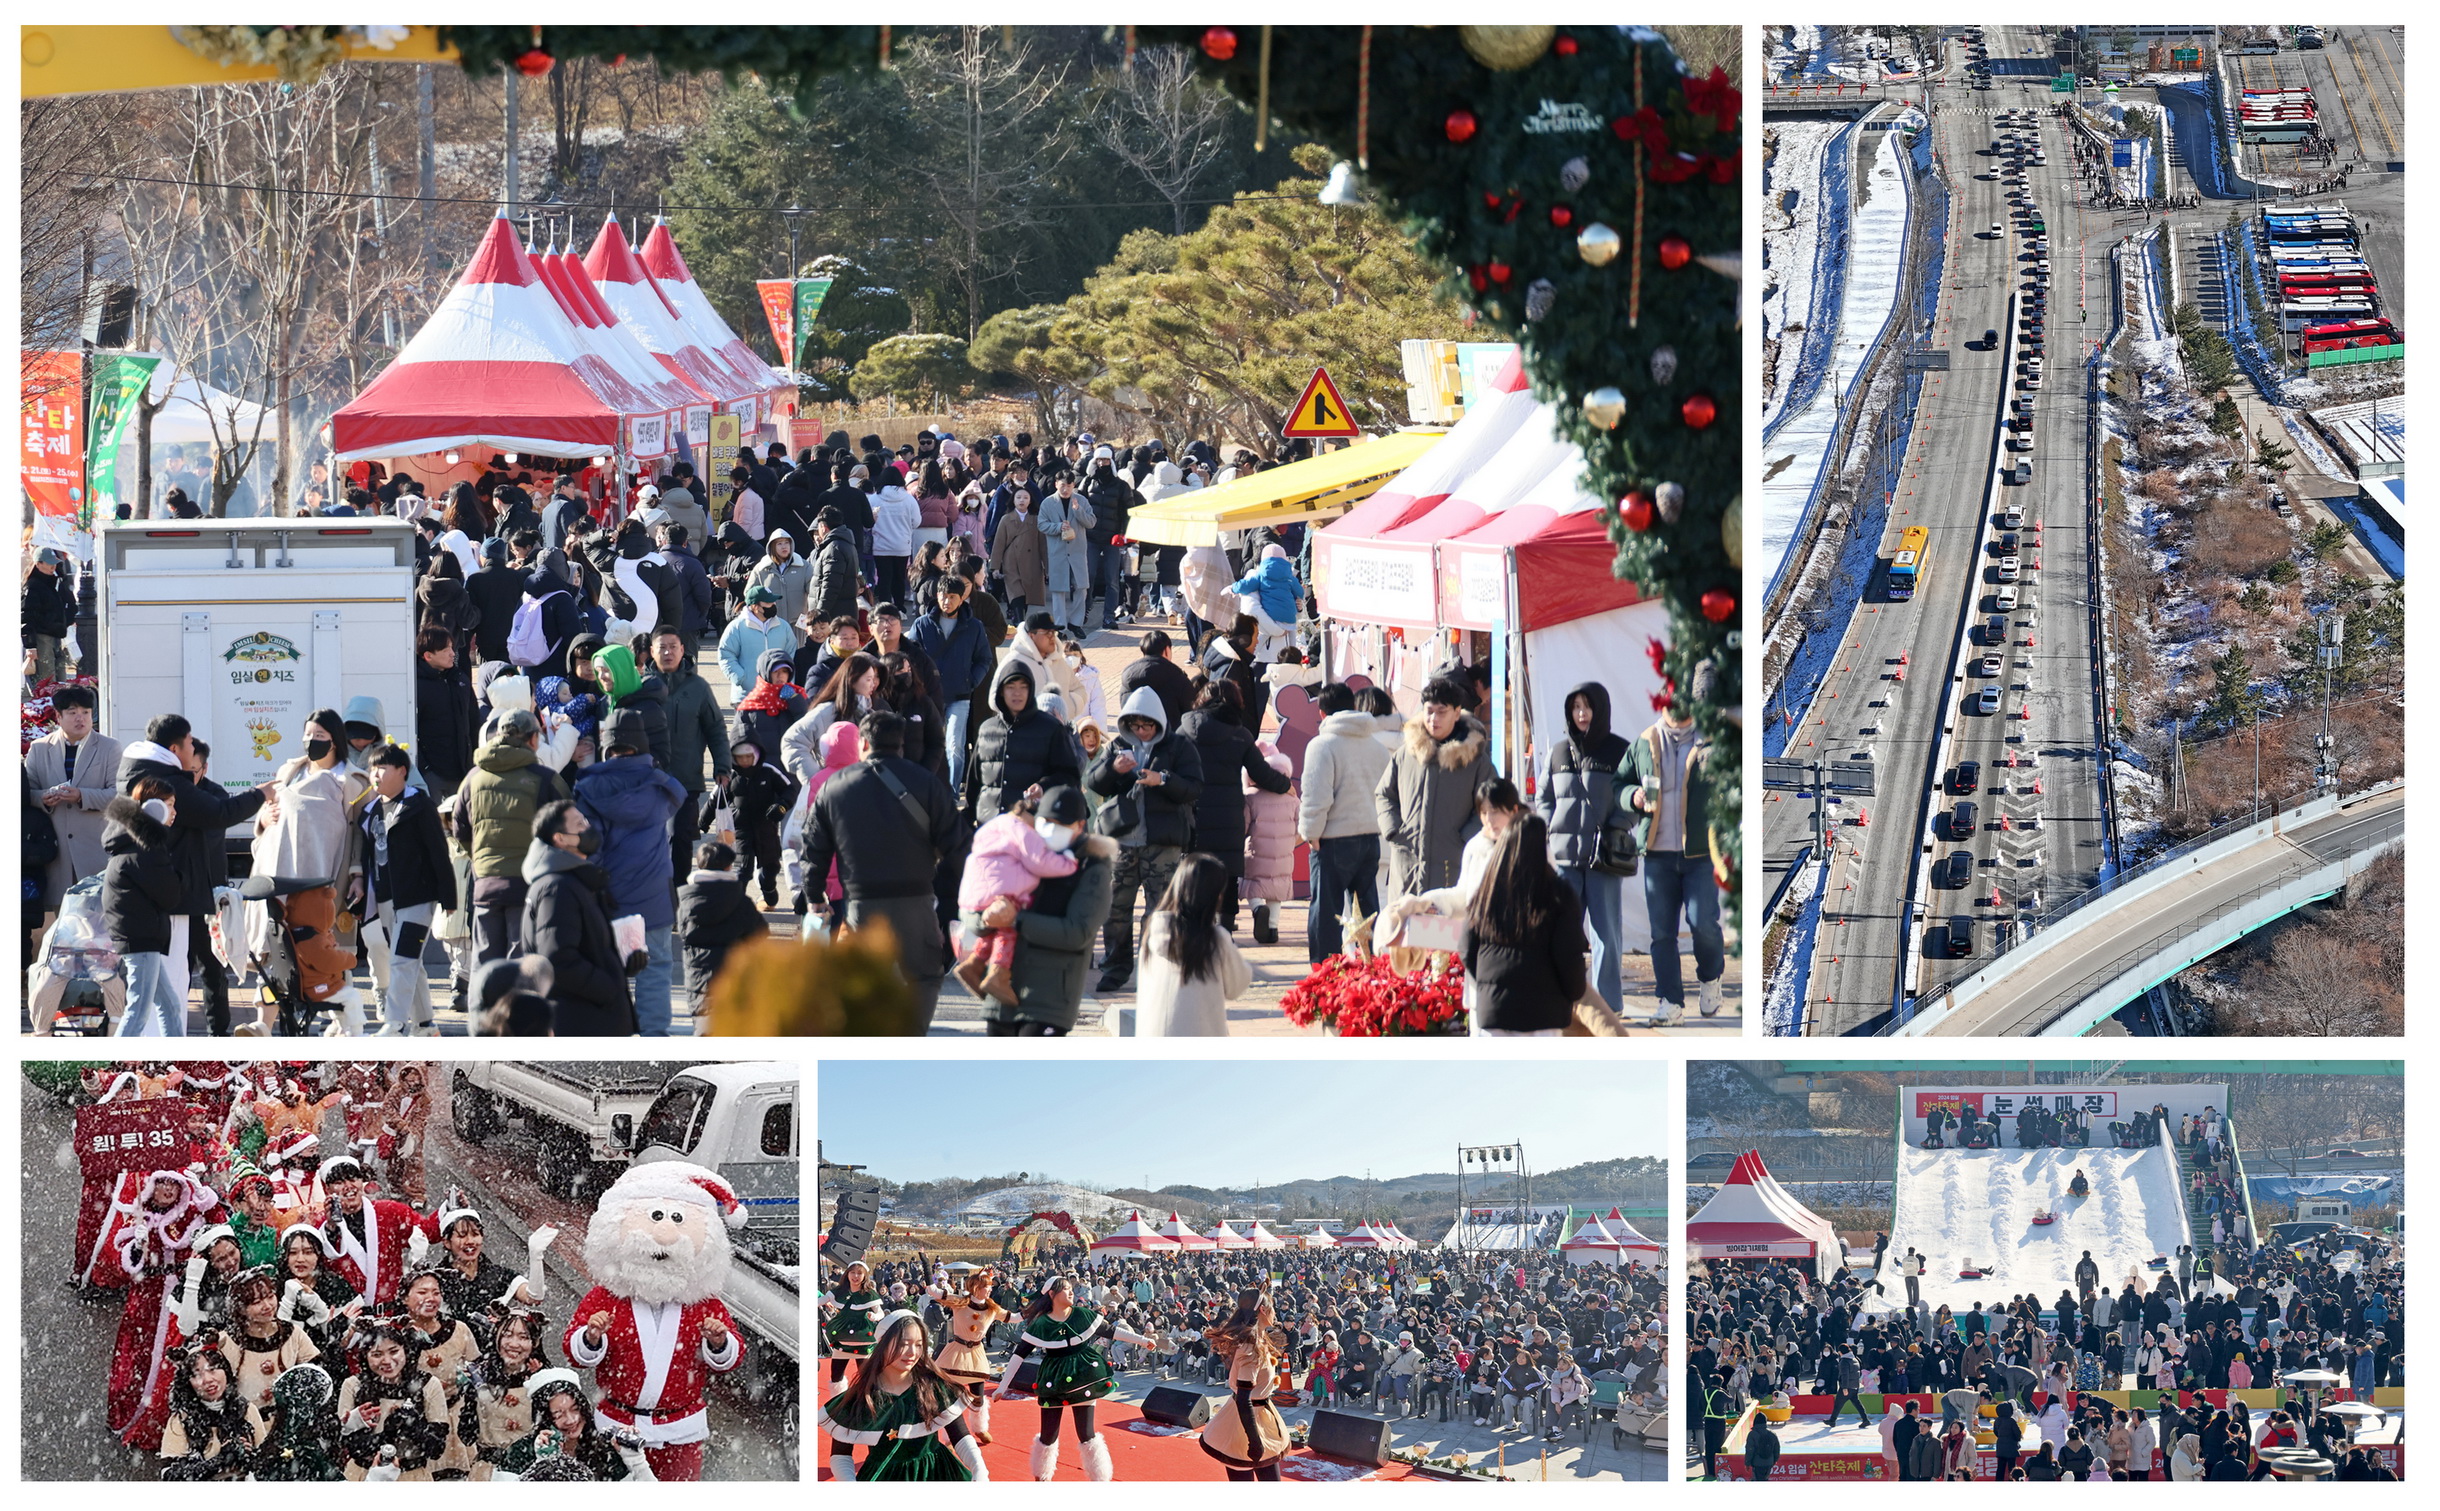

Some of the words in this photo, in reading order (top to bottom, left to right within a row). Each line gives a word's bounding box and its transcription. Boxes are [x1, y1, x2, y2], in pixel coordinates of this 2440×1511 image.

[24, 430, 71, 458] 축제
[711, 446, 725, 459] 바로
[711, 482, 734, 498] 찰붕어
[233, 636, 254, 649] IMSIL
[270, 636, 292, 649] CHEESE
[92, 1134, 116, 1153] 원!
[120, 1132, 144, 1150] 투!
[149, 1128, 175, 1147] 35
[1787, 1464, 1807, 1475] 임실
[1809, 1459, 1861, 1475] 산타축제
